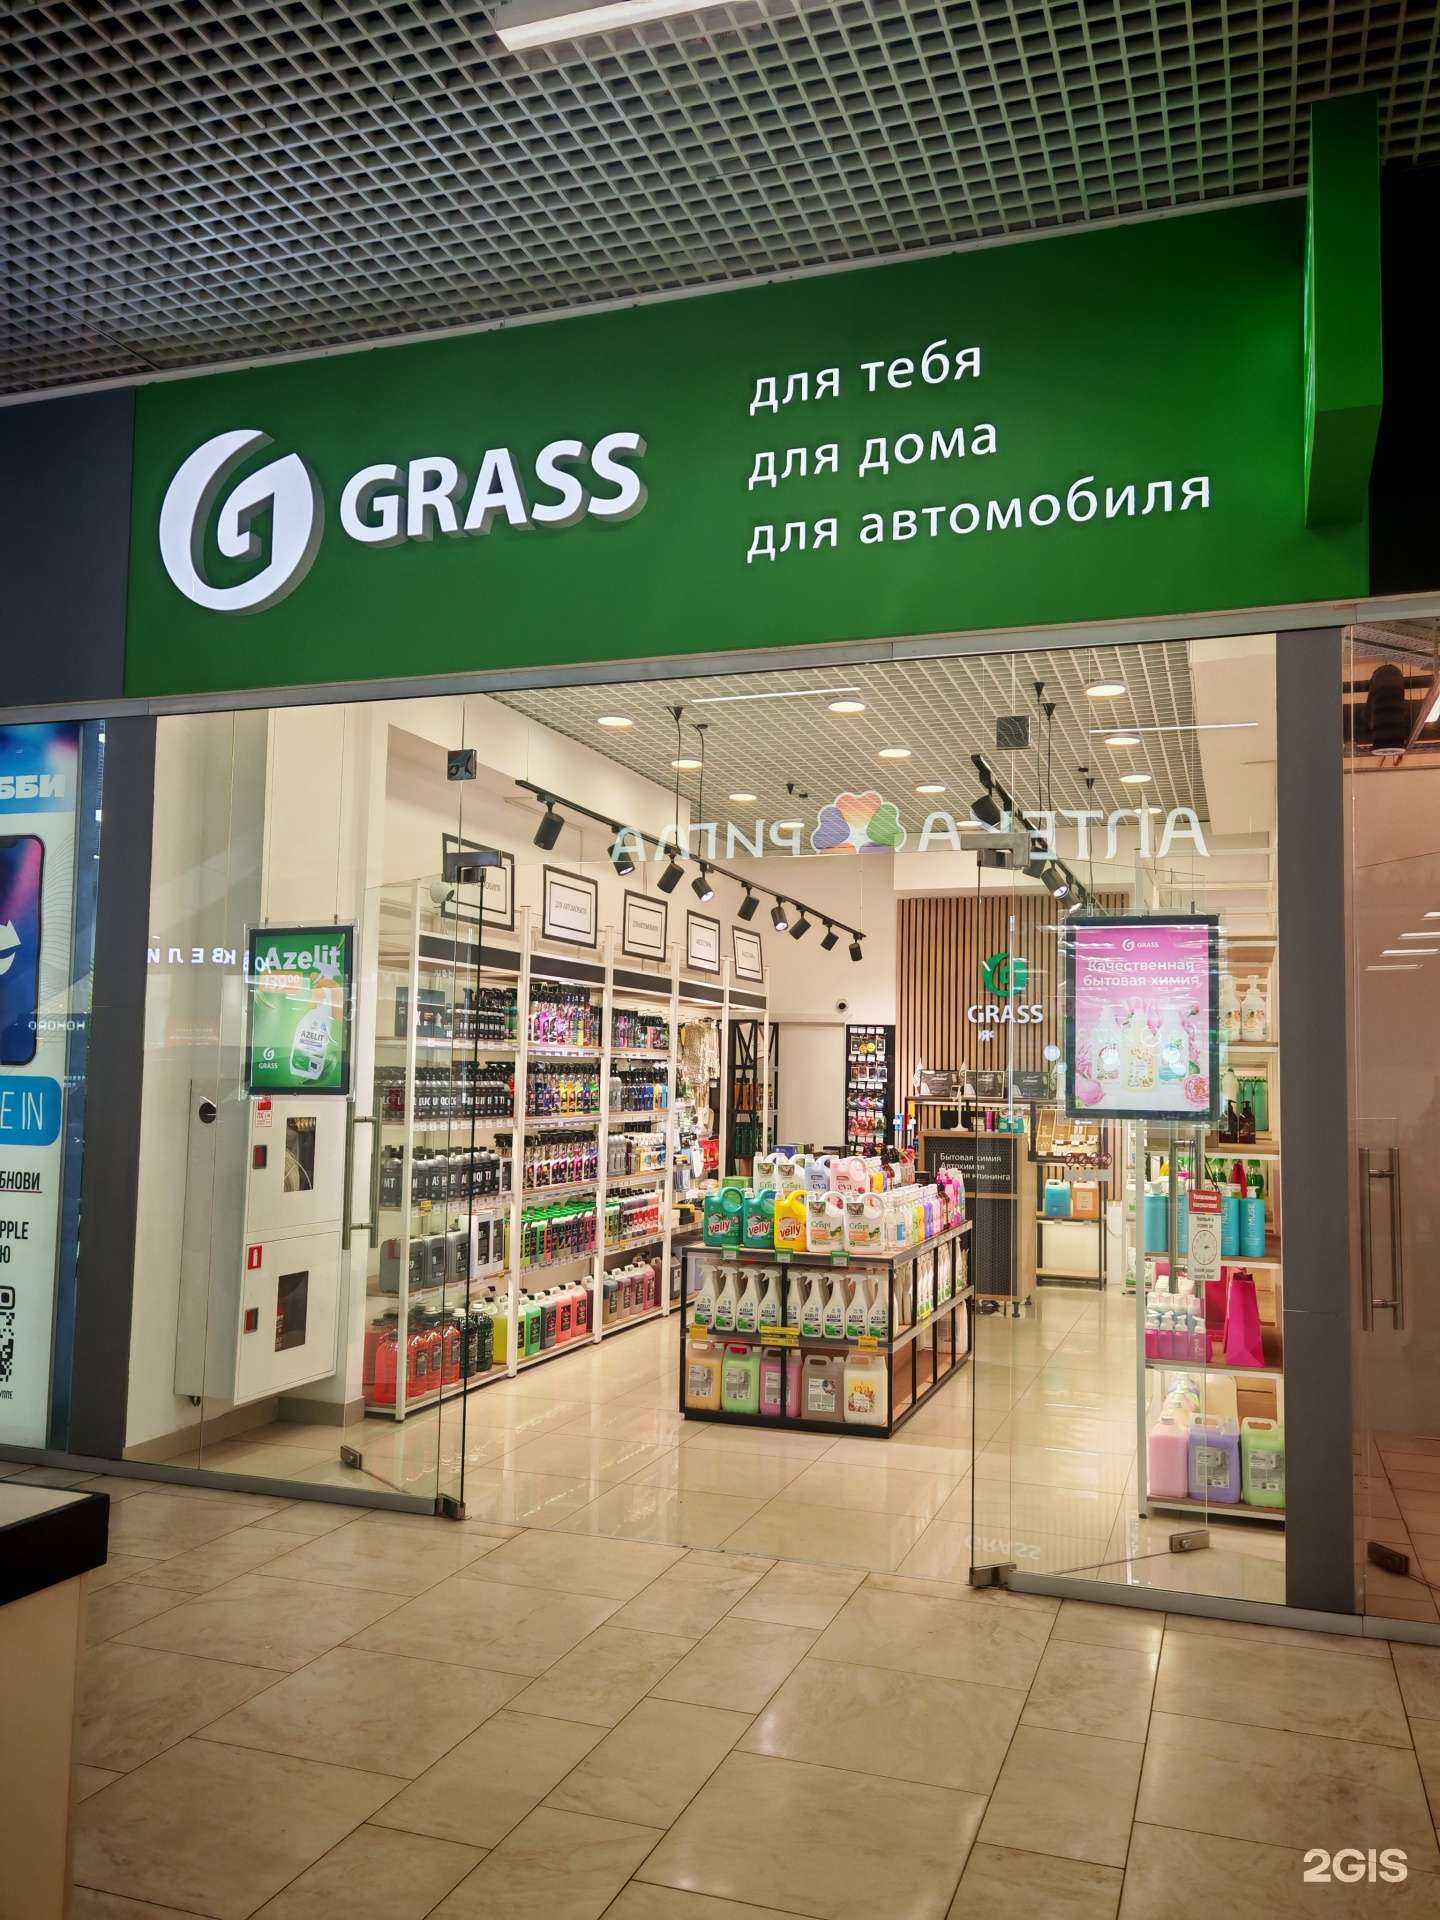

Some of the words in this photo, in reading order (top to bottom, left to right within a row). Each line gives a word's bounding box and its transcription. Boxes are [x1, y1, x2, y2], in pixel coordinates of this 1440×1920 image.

[750, 367, 840, 416] для
[861, 339, 981, 392] тебя
[748, 443, 839, 490] для
[858, 423, 997, 477] дома
[340, 432, 644, 544] GRASS
[747, 518, 838, 563] для
[859, 476, 1210, 545] автомобиля
[266, 944, 340, 970] Azelit
[1087, 959, 1195, 972] Качественная
[1083, 974, 1146, 987] бытовая
[1151, 975, 1200, 986] химия
[967, 1004, 1044, 1024] GRASS
[258, 1062, 279, 1070] GRASS
[22, 1091, 43, 1131] IN
[940, 1152, 974, 1162] Бытовая
